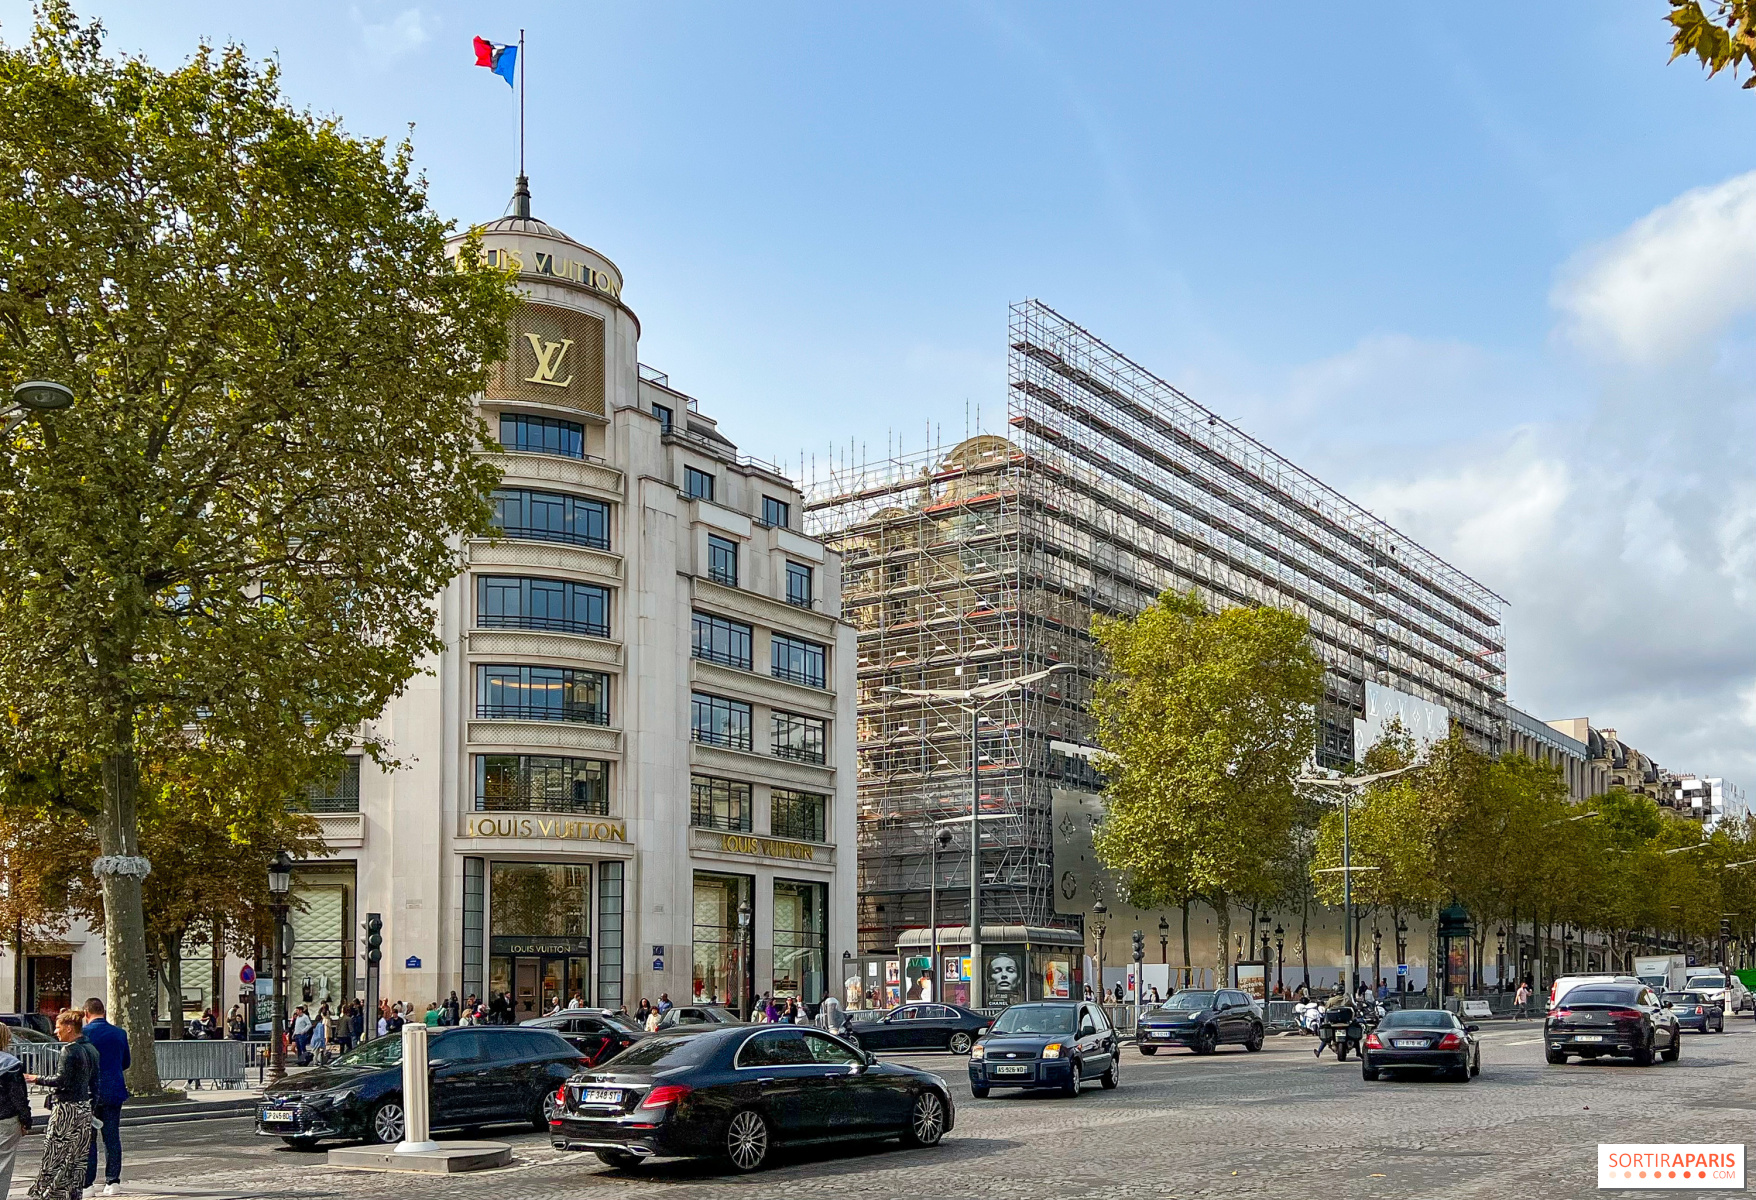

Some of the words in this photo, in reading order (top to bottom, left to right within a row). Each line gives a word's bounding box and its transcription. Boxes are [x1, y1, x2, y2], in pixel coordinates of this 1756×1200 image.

[533, 252, 622, 298] VUITTON
[469, 818, 533, 838] LOUIS
[538, 819, 625, 842] VUITTON
[722, 834, 758, 854] LOUIS
[761, 840, 813, 860] VUITTON
[510, 945, 534, 953] LOUIS
[535, 945, 571, 953] VUITTON
